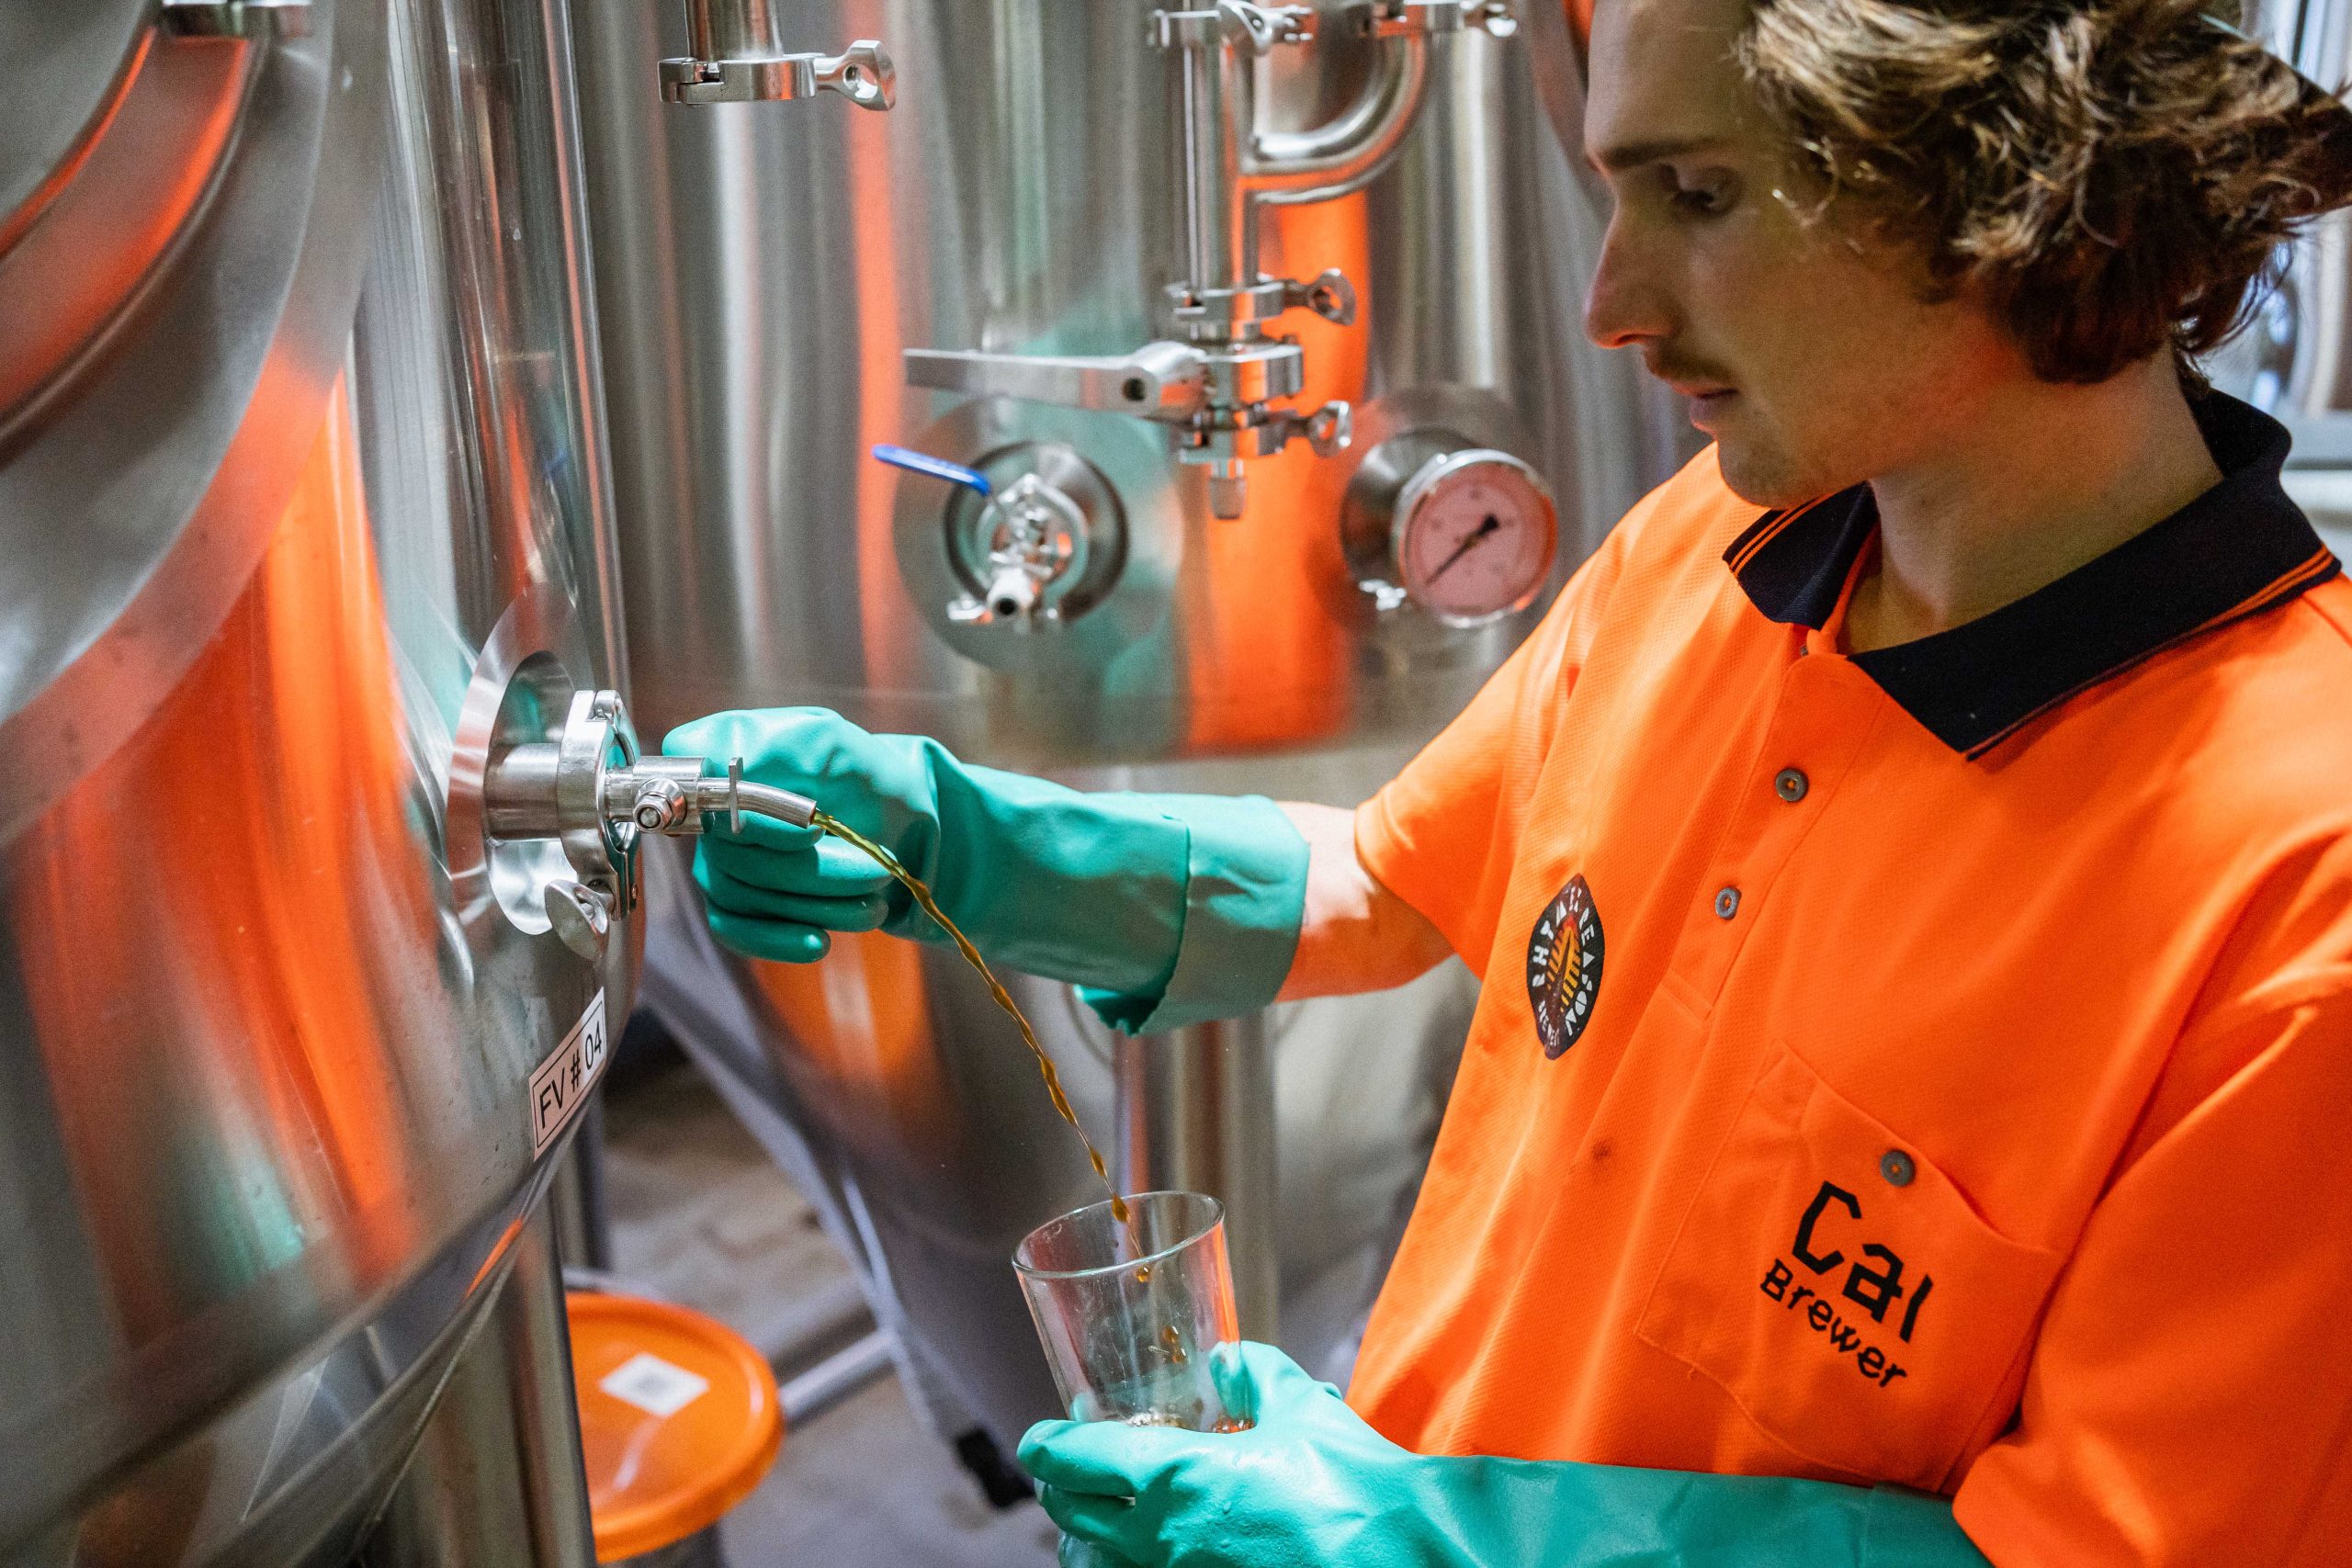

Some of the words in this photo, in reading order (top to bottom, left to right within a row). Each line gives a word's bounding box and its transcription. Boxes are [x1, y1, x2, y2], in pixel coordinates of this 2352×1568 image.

[539, 1067, 565, 1129] FV
[570, 1048, 582, 1093] #
[584, 1021, 602, 1071] 04
[1759, 1258, 1907, 1388] Brewer
[1792, 1179, 1933, 1344] Cal
